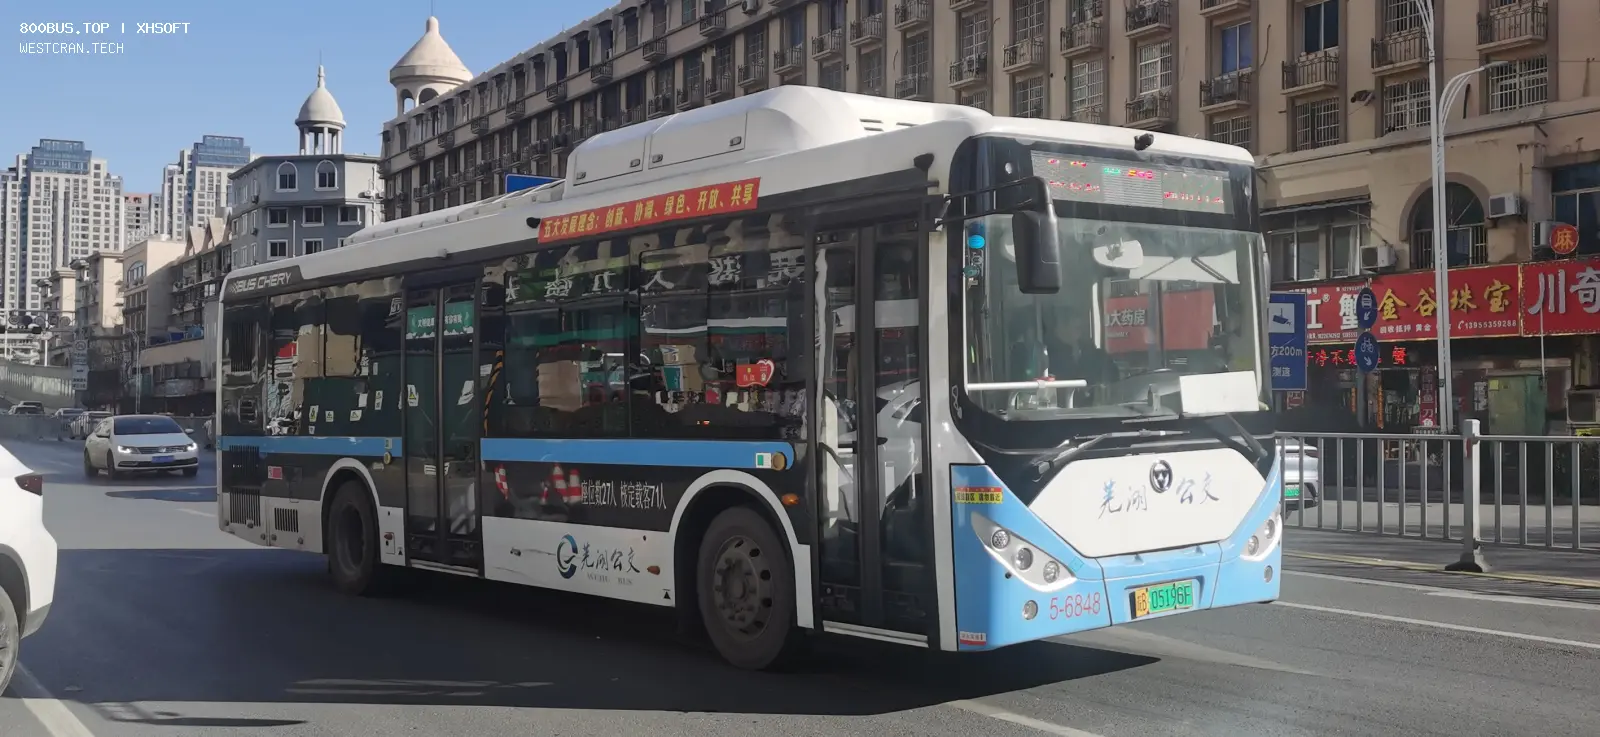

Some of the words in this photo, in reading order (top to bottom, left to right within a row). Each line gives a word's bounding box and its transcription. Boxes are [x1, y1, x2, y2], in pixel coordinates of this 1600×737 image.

[1554, 229, 1574, 250] 麻
[257, 272, 292, 289] CHERY
[1050, 592, 1101, 620] 5-6848
